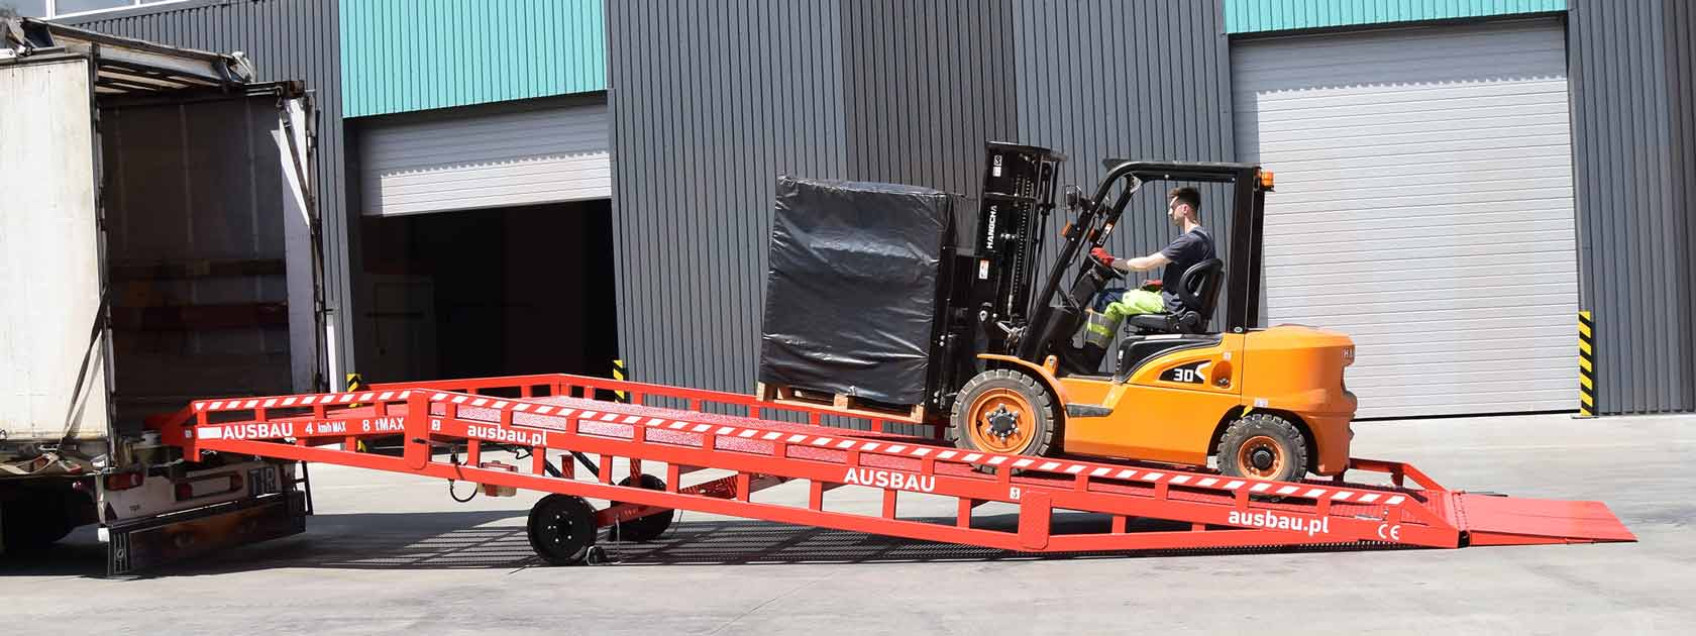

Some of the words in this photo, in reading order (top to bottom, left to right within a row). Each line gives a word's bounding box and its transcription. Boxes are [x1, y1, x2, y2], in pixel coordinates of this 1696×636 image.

[986, 205, 998, 249] HANGCHA
[1173, 368, 1194, 382] 30
[223, 423, 294, 440] AUSBAU
[305, 422, 314, 435] 4
[362, 419, 371, 432] 8
[468, 424, 547, 446] ausbau.pl
[249, 468, 275, 496] TIR
[844, 468, 935, 491] AUSBAU
[1228, 509, 1329, 537] ausbau.pl
[1377, 523, 1401, 541] CE
